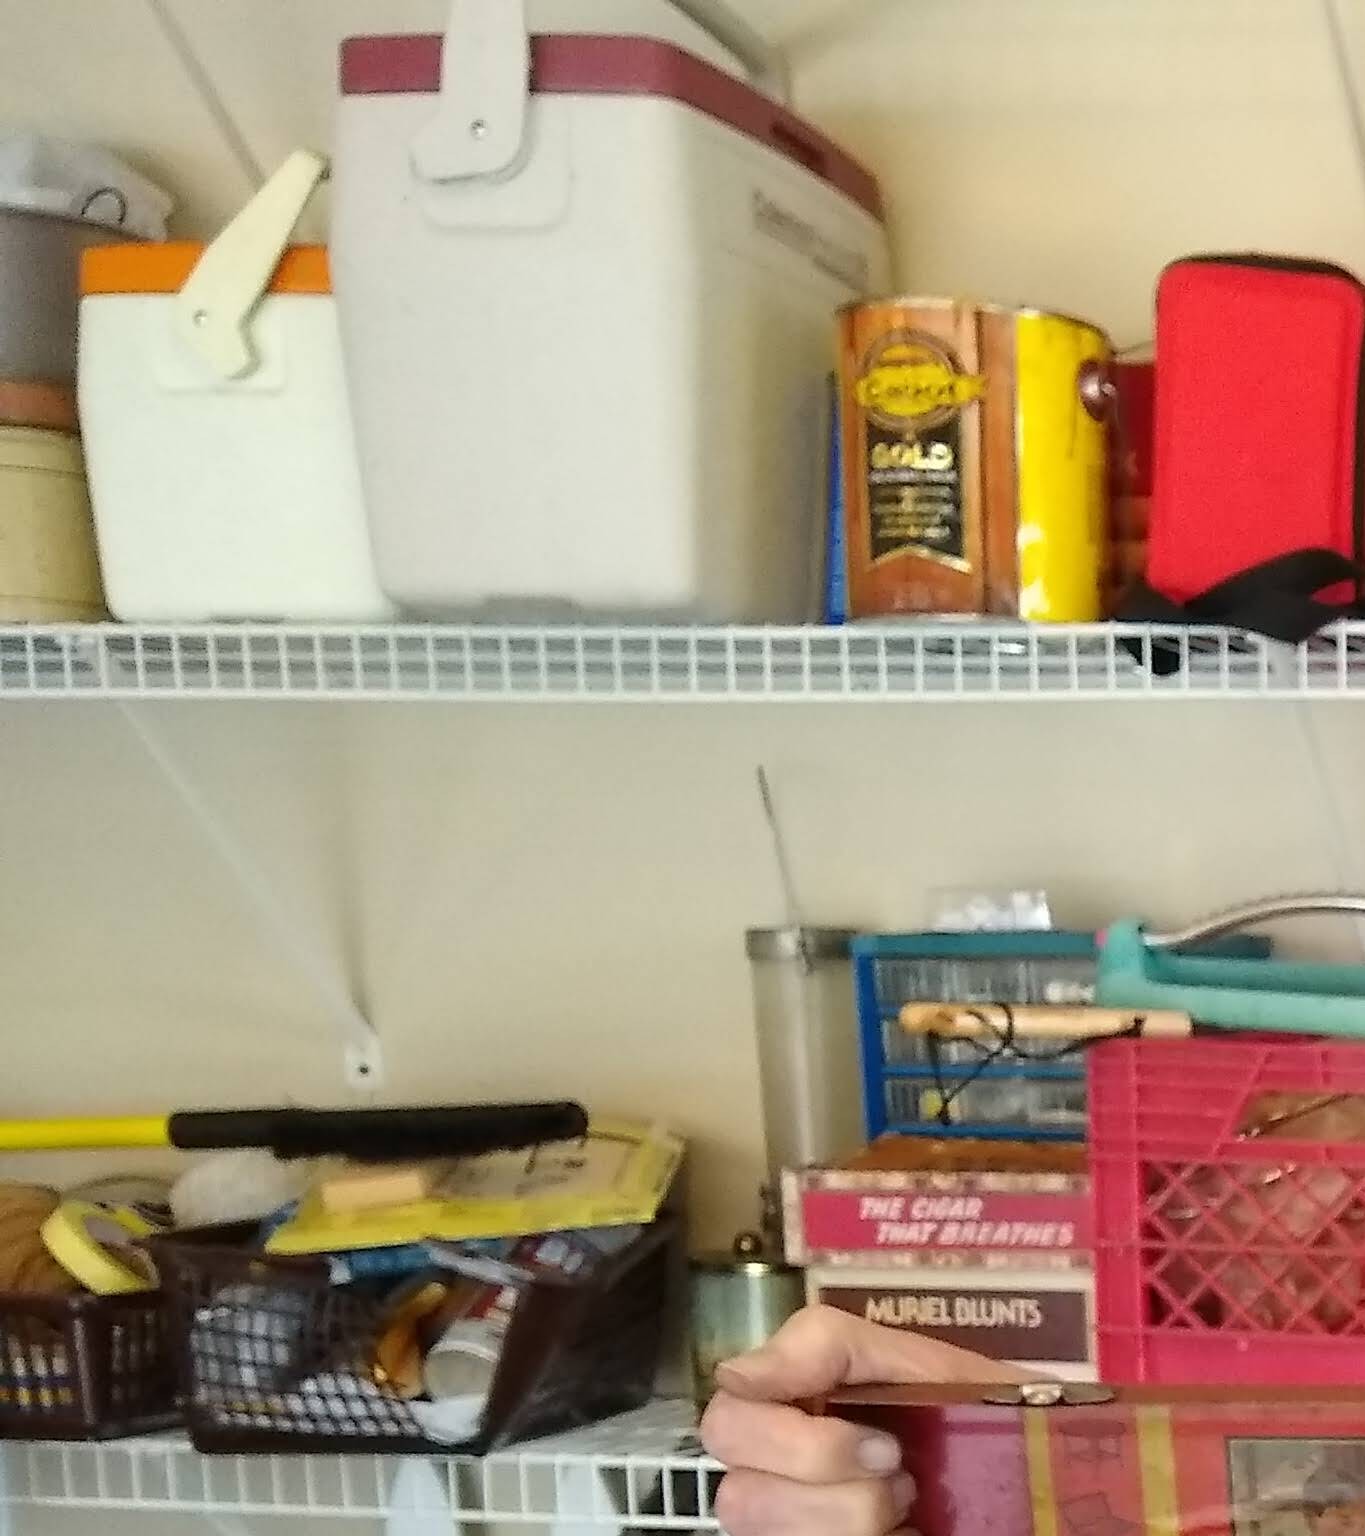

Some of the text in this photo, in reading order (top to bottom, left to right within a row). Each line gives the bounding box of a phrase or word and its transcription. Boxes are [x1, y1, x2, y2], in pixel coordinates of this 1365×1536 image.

[860, 1196, 984, 1221] THE CIGAR
[876, 1221, 1075, 1247] THAT BREATHES
[866, 1297, 1042, 1328] MURIEL BLUNTS
